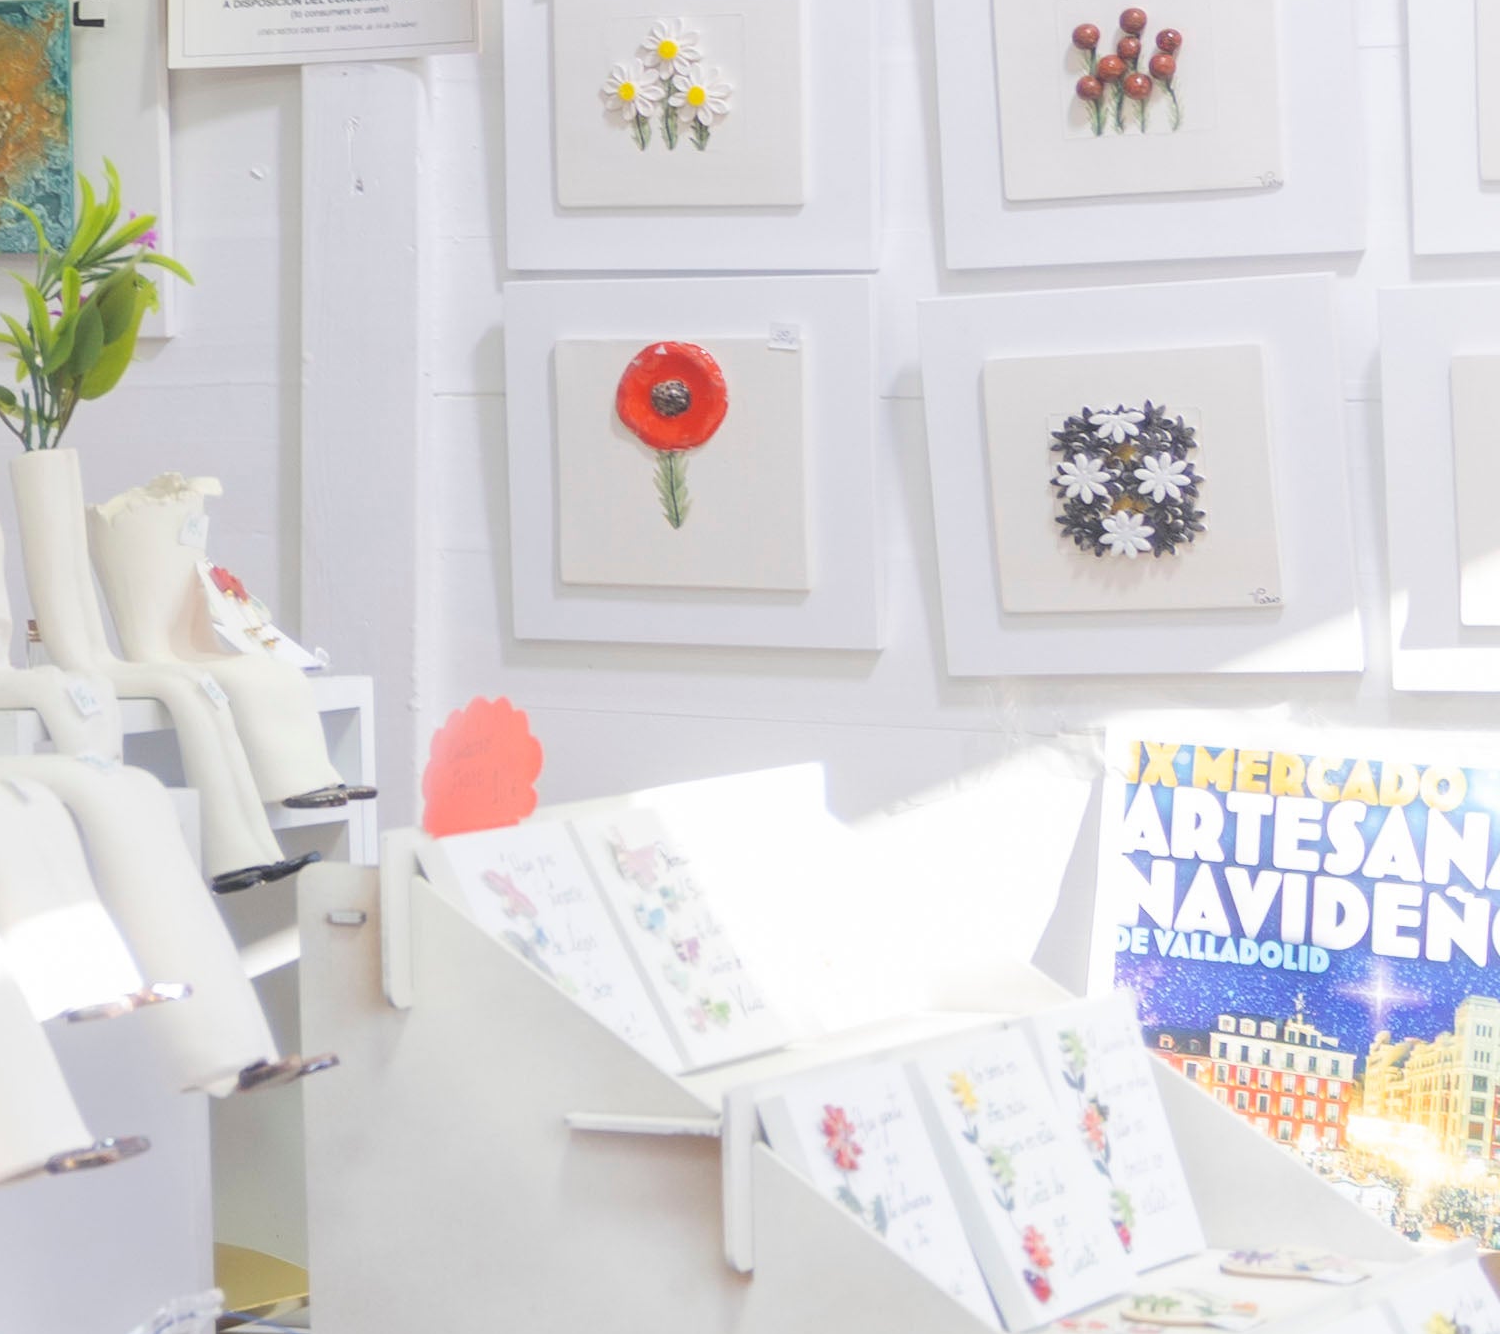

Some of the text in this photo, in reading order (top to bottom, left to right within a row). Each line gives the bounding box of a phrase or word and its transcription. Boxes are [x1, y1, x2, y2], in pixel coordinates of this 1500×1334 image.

[223, 0, 231, 8] A
[1192, 745, 1468, 812] MERCADO
[1121, 783, 1500, 890] ARTESAN
[1116, 853, 1500, 967] NAVIDEÑ
[1115, 925, 1331, 974] DE VALLADOLID
